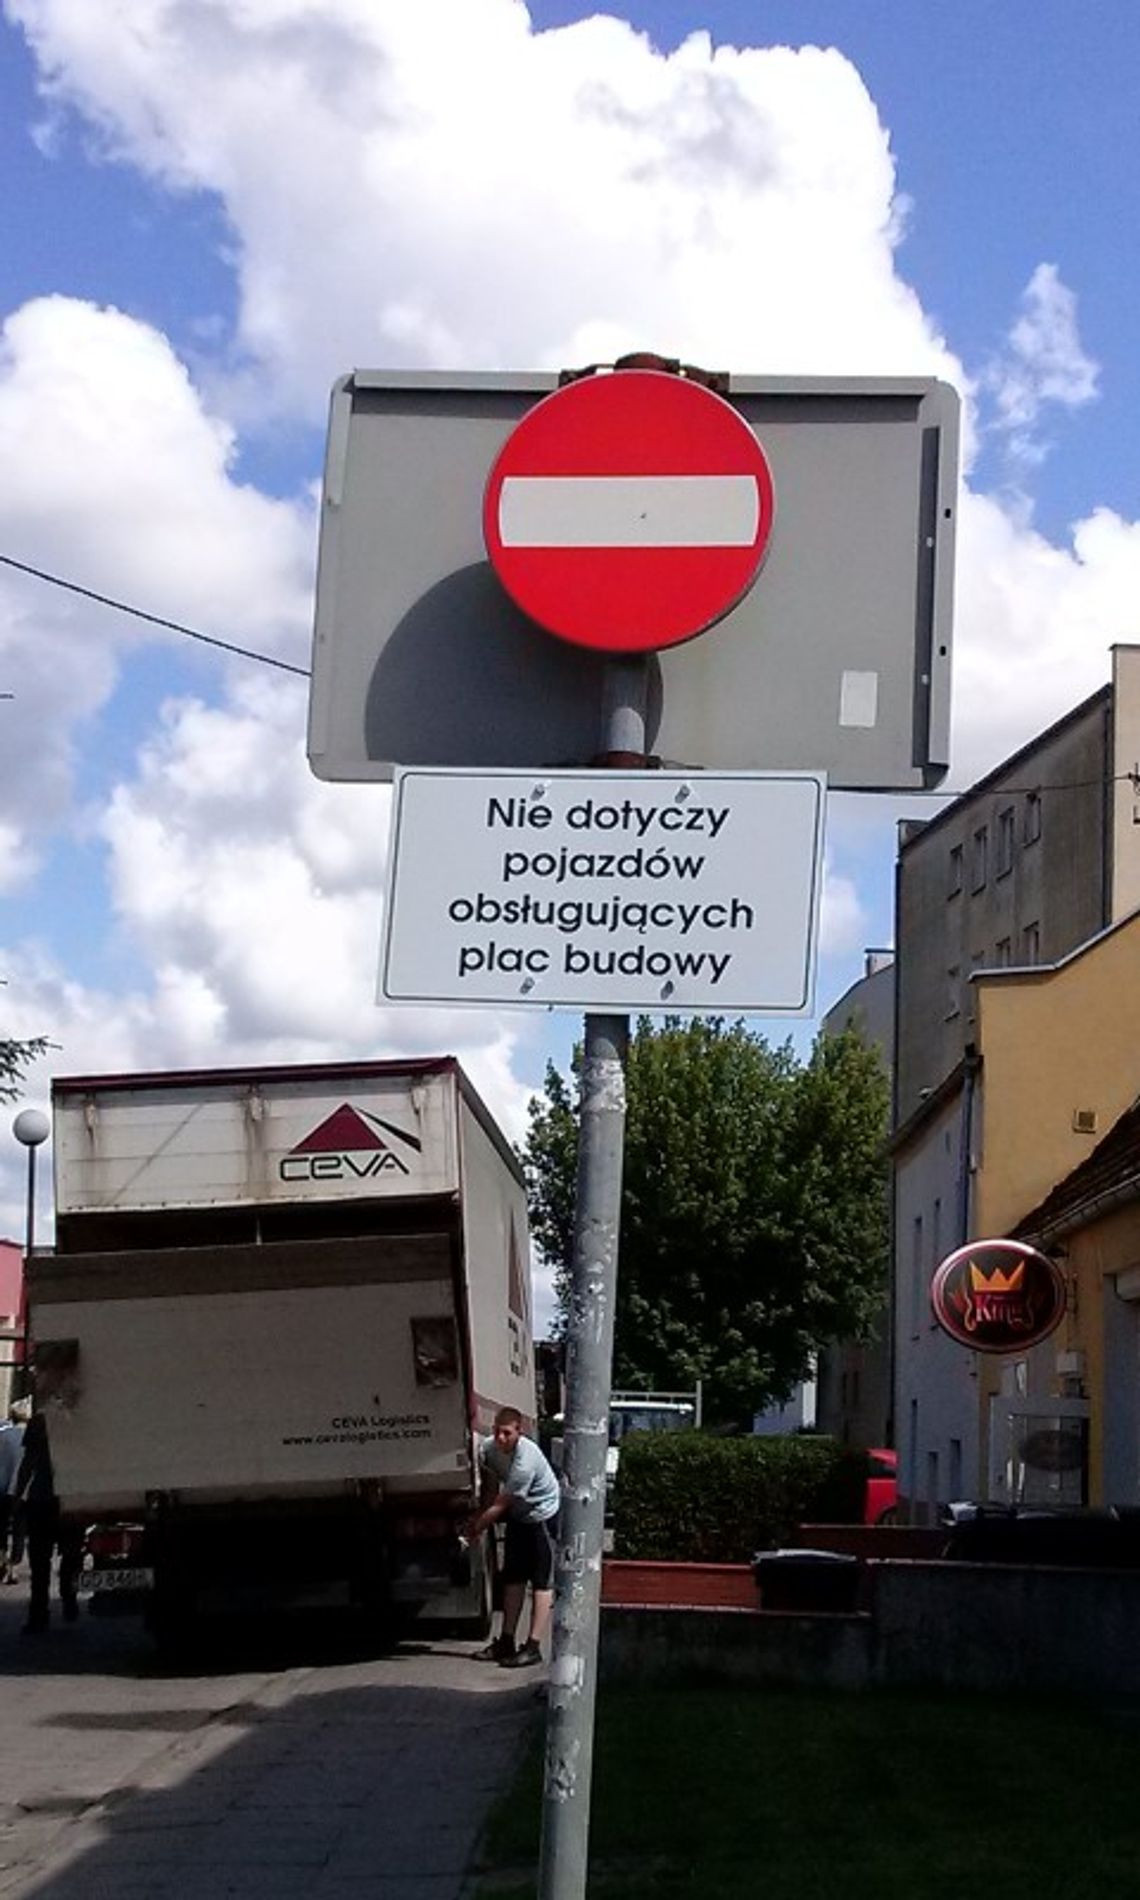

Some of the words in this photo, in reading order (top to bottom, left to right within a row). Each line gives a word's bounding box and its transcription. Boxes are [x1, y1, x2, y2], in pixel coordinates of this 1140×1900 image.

[488, 798, 552, 828] Nie
[567, 801, 729, 837] dotyczy
[504, 847, 704, 883] pojazdów
[449, 893, 753, 934] obsługujących
[459, 942, 549, 976] plac
[565, 944, 731, 984] budowy
[332, 1417, 369, 1429] CEVA
[371, 1414, 430, 1428] Logistics
